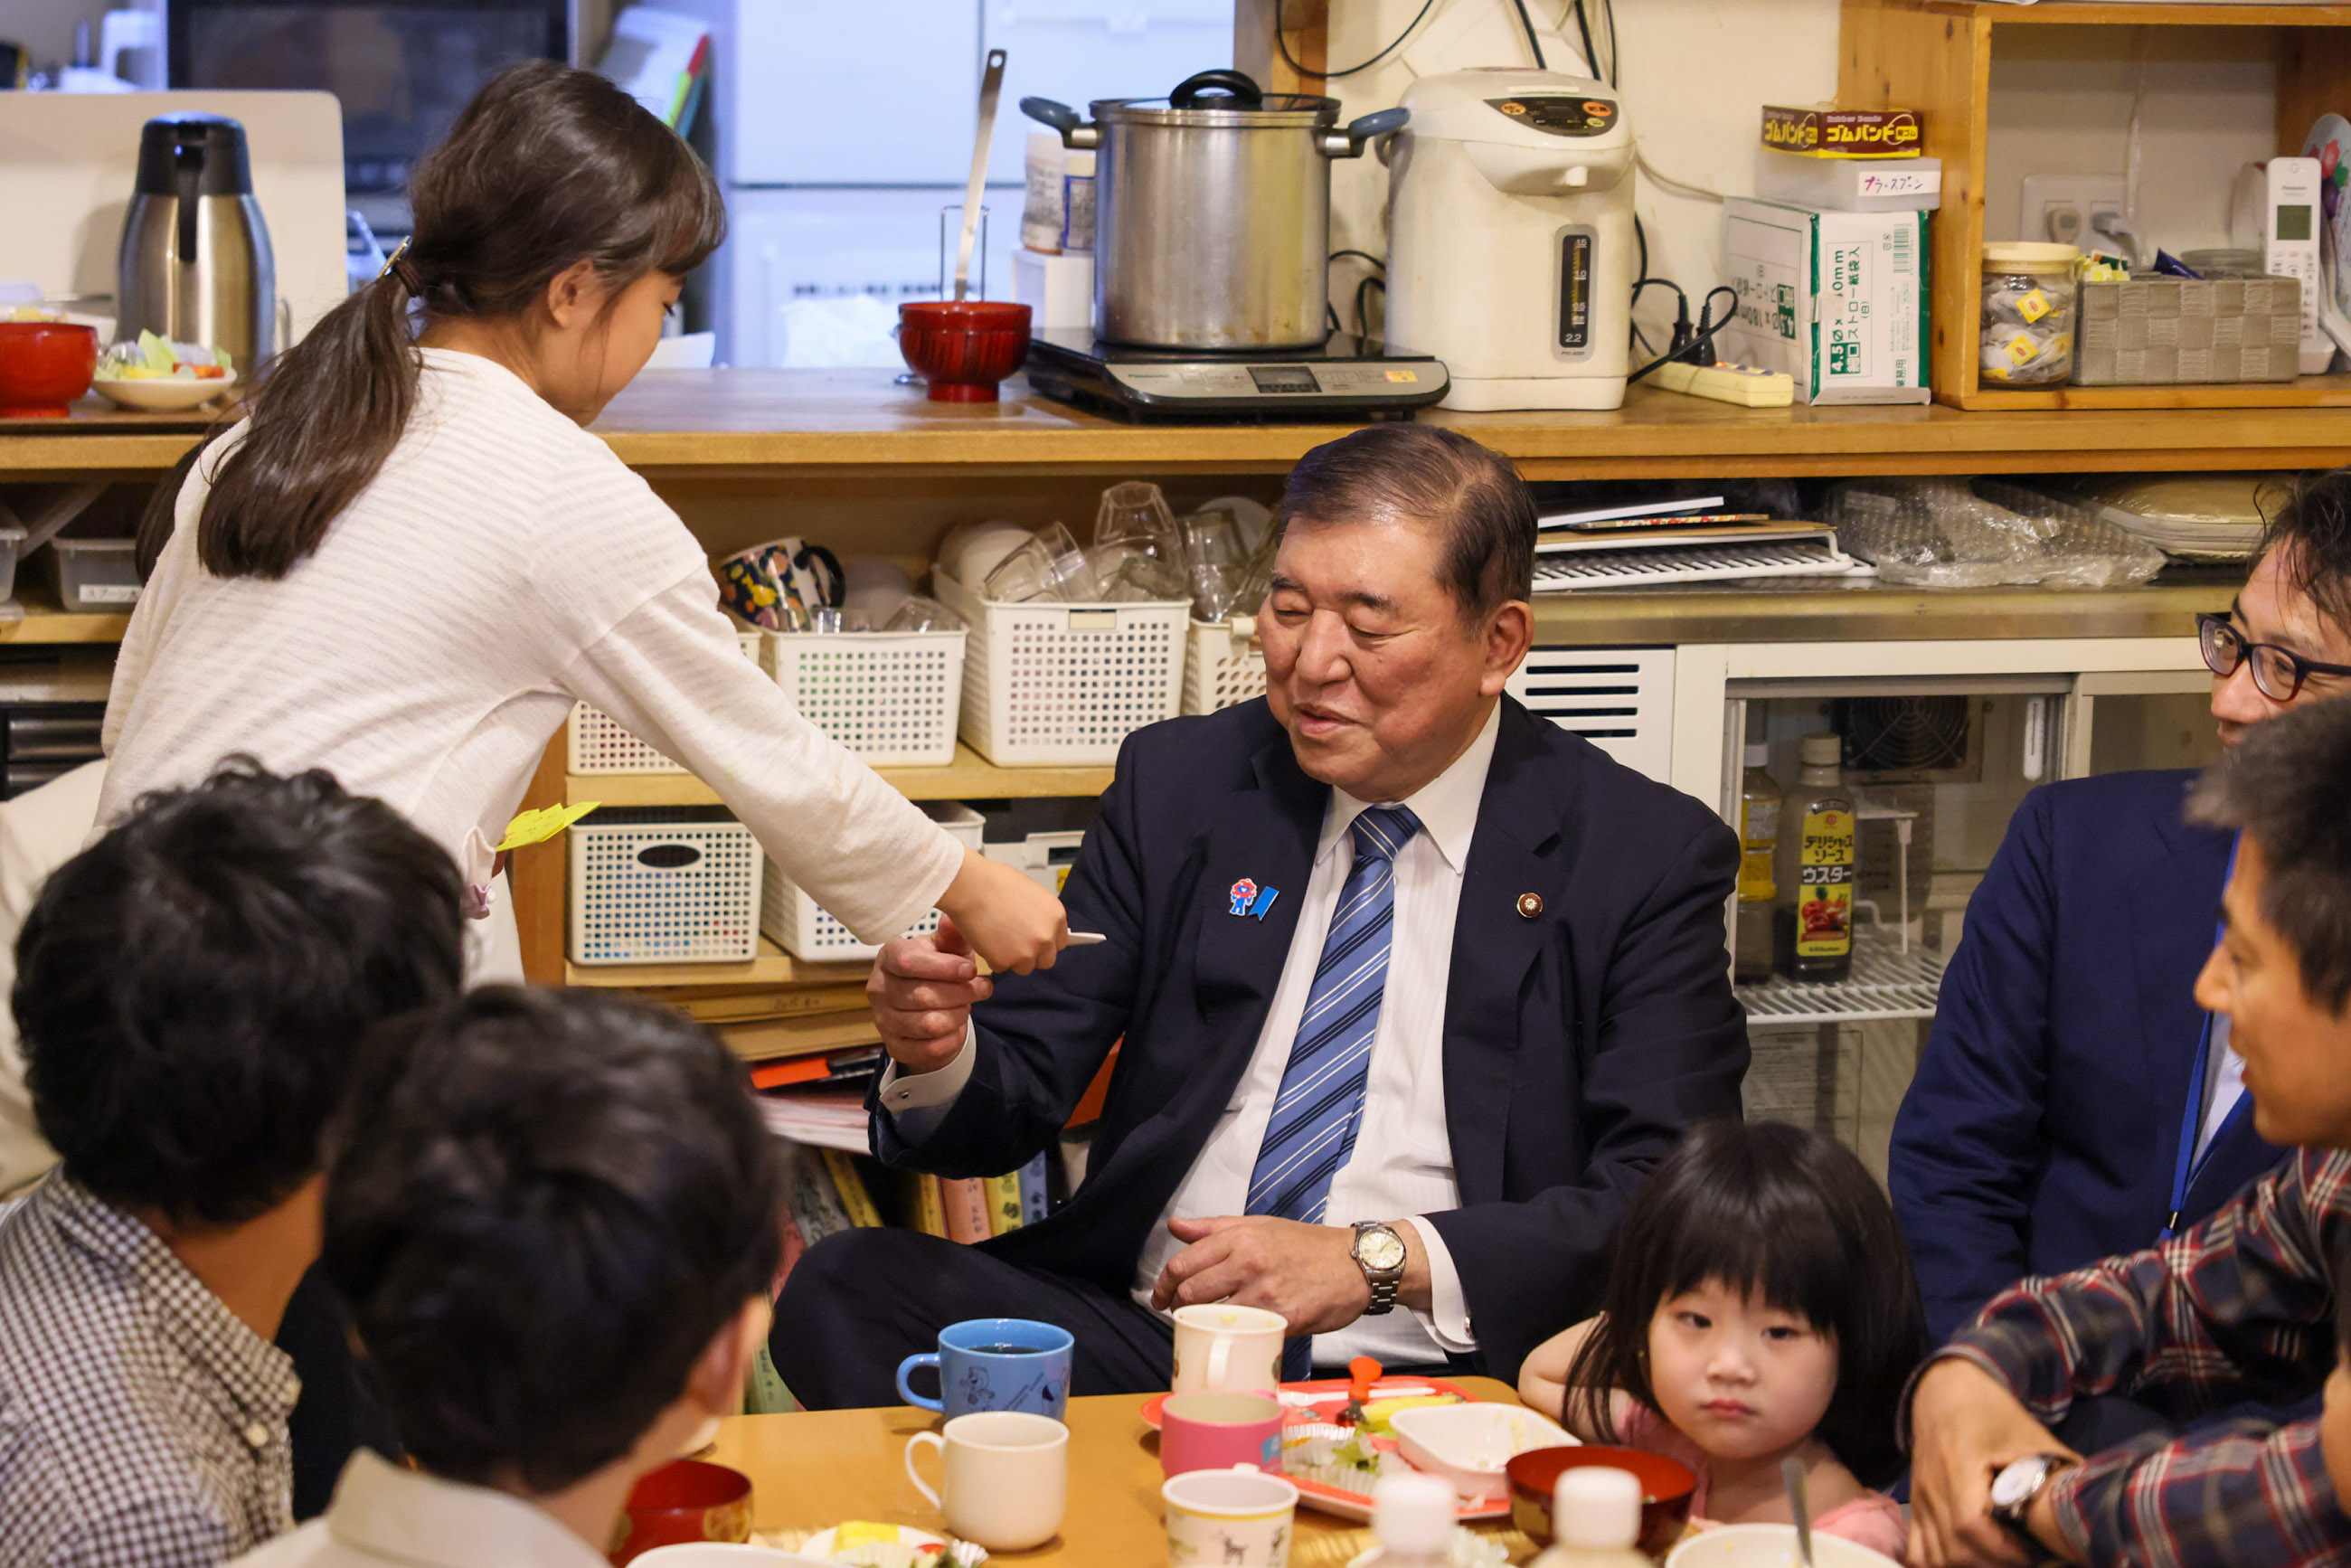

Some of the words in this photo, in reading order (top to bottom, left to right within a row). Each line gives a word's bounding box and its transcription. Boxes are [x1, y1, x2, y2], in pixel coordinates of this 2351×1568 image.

[1764, 118, 1806, 145] ゴムバンド
[1827, 125, 1895, 142] ゴムバンド
[1804, 835, 1853, 848] デリシャス
[1815, 850, 1845, 863] ソース
[1802, 866, 1852, 883] ウスター
